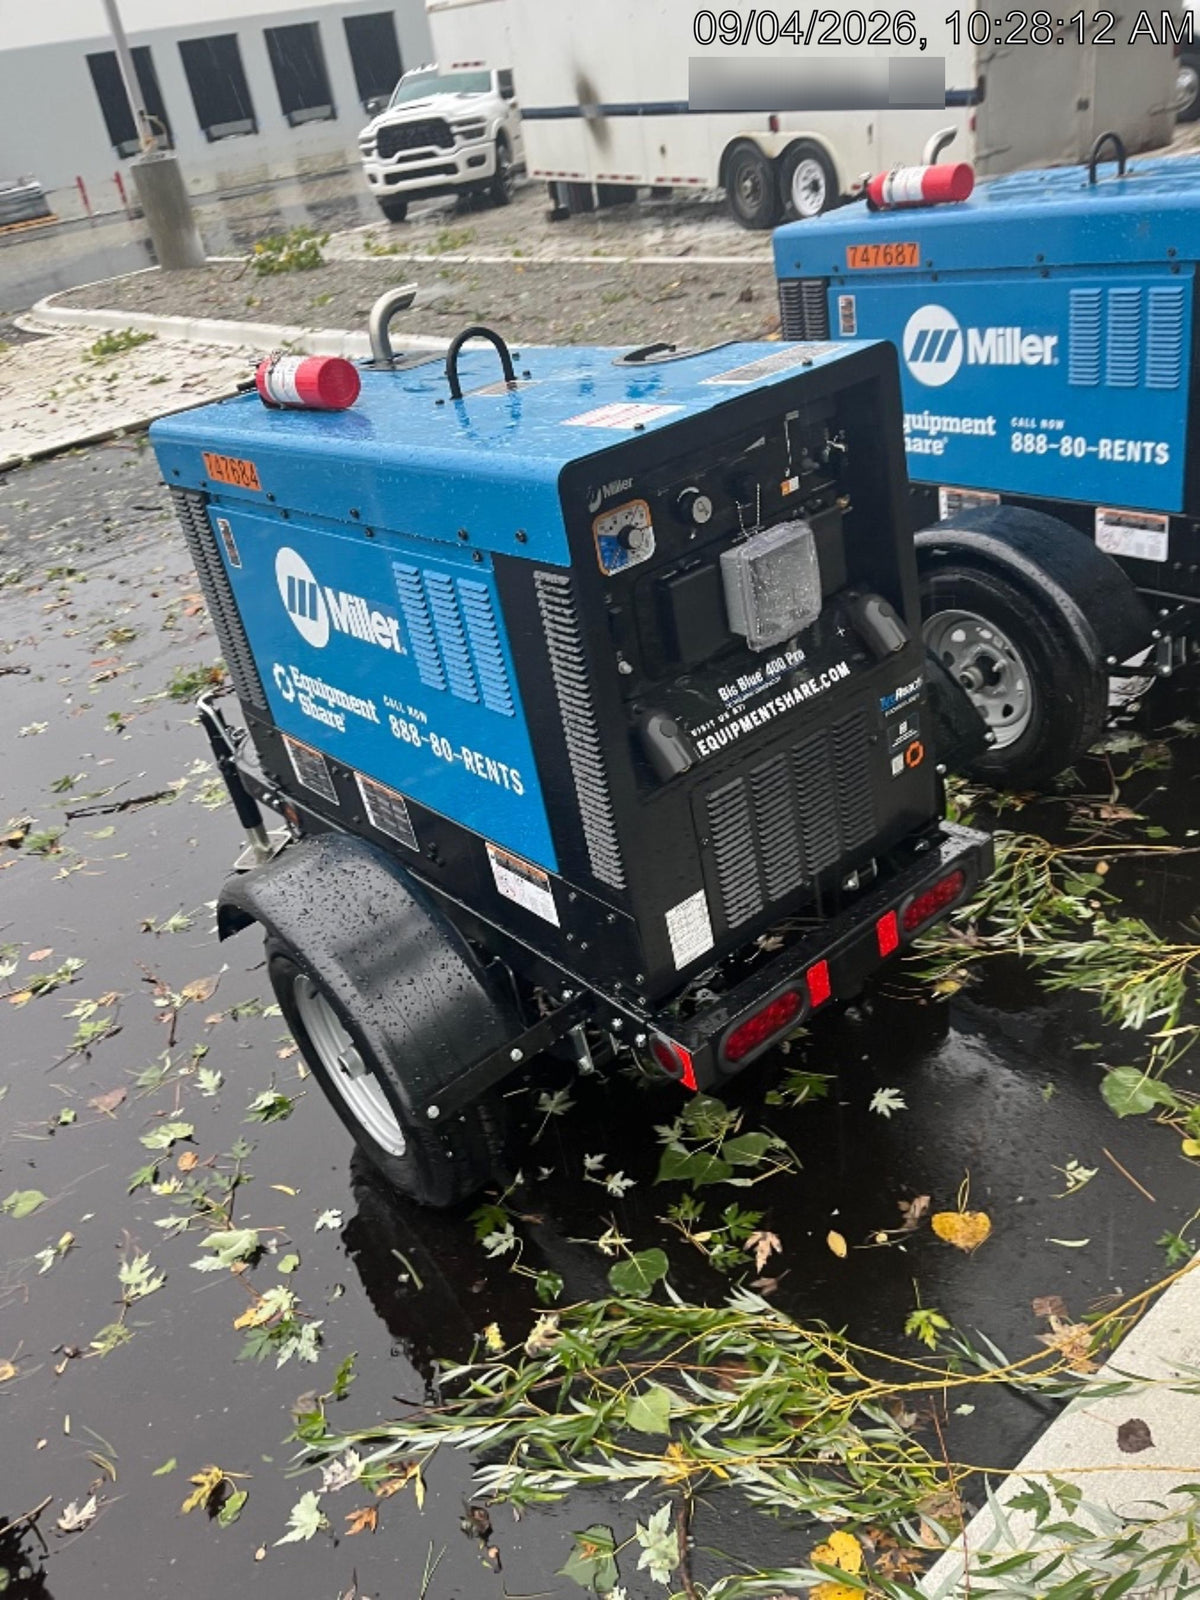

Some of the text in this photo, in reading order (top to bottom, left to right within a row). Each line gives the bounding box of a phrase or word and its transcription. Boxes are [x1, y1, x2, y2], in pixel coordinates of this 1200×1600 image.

[848, 243, 918, 267] 747687
[966, 326, 1057, 366] Miller
[903, 409, 997, 437] quipment
[1010, 432, 1170, 465] 888-80-RENTS
[203, 452, 260, 489] 747684
[324, 586, 403, 653] Miller
[289, 664, 381, 725] Equipment
[298, 691, 346, 733] Share
[696, 660, 851, 757] EQUIPMENTSHARE.COM
[388, 713, 525, 796] 888-80-RENTS
